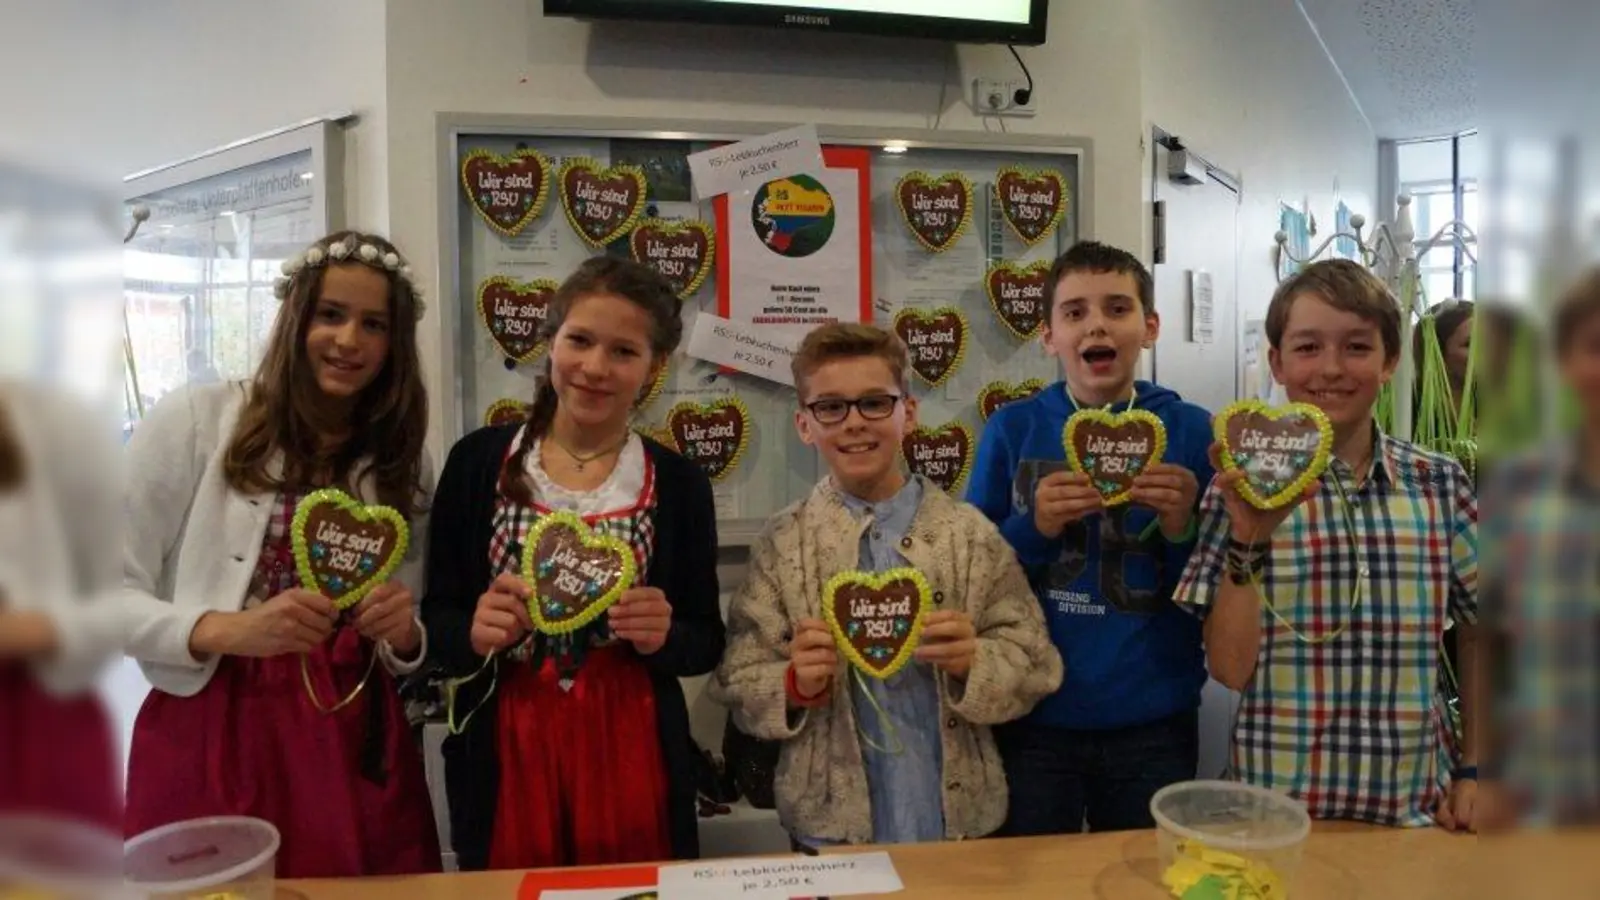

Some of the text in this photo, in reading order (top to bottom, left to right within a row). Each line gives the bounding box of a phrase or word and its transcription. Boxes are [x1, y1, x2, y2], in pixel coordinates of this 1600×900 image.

[784, 14, 831, 26] SAMSUNG
[478, 171, 534, 189] Wir sind
[490, 190, 519, 208] RSU
[575, 180, 629, 205] Wir sind
[911, 193, 960, 210] Wir sind
[1009, 185, 1054, 206] Wir sind
[585, 201, 612, 220] RSU
[922, 211, 947, 226] RSU
[1018, 204, 1042, 220] RSU
[646, 240, 698, 259] Wir sind
[657, 259, 685, 275] RSU
[1001, 282, 1021, 298] Wir
[494, 298, 548, 319] Wir sind
[1010, 300, 1035, 314] RSU
[504, 319, 532, 336] RSU
[906, 328, 955, 345] Wir sind
[918, 346, 943, 361] RSU
[683, 421, 736, 440] Wir sind
[1239, 428, 1309, 450] Wir sind
[695, 441, 722, 456] RSU
[912, 442, 960, 460] Wir sind
[1085, 435, 1149, 454] Wir sind
[923, 461, 949, 476] RSU
[1098, 456, 1130, 474] RSU
[1255, 450, 1290, 472] RSU
[315, 520, 385, 556] Wir sind
[327, 547, 362, 572] RSU
[551, 541, 614, 585] Wir sind
[553, 569, 587, 596] RSU
[848, 595, 912, 618] Wir sind
[1058, 601, 1107, 616] DIVISION
[863, 619, 894, 639] RSU
[741, 877, 815, 892] je 2,50 €
